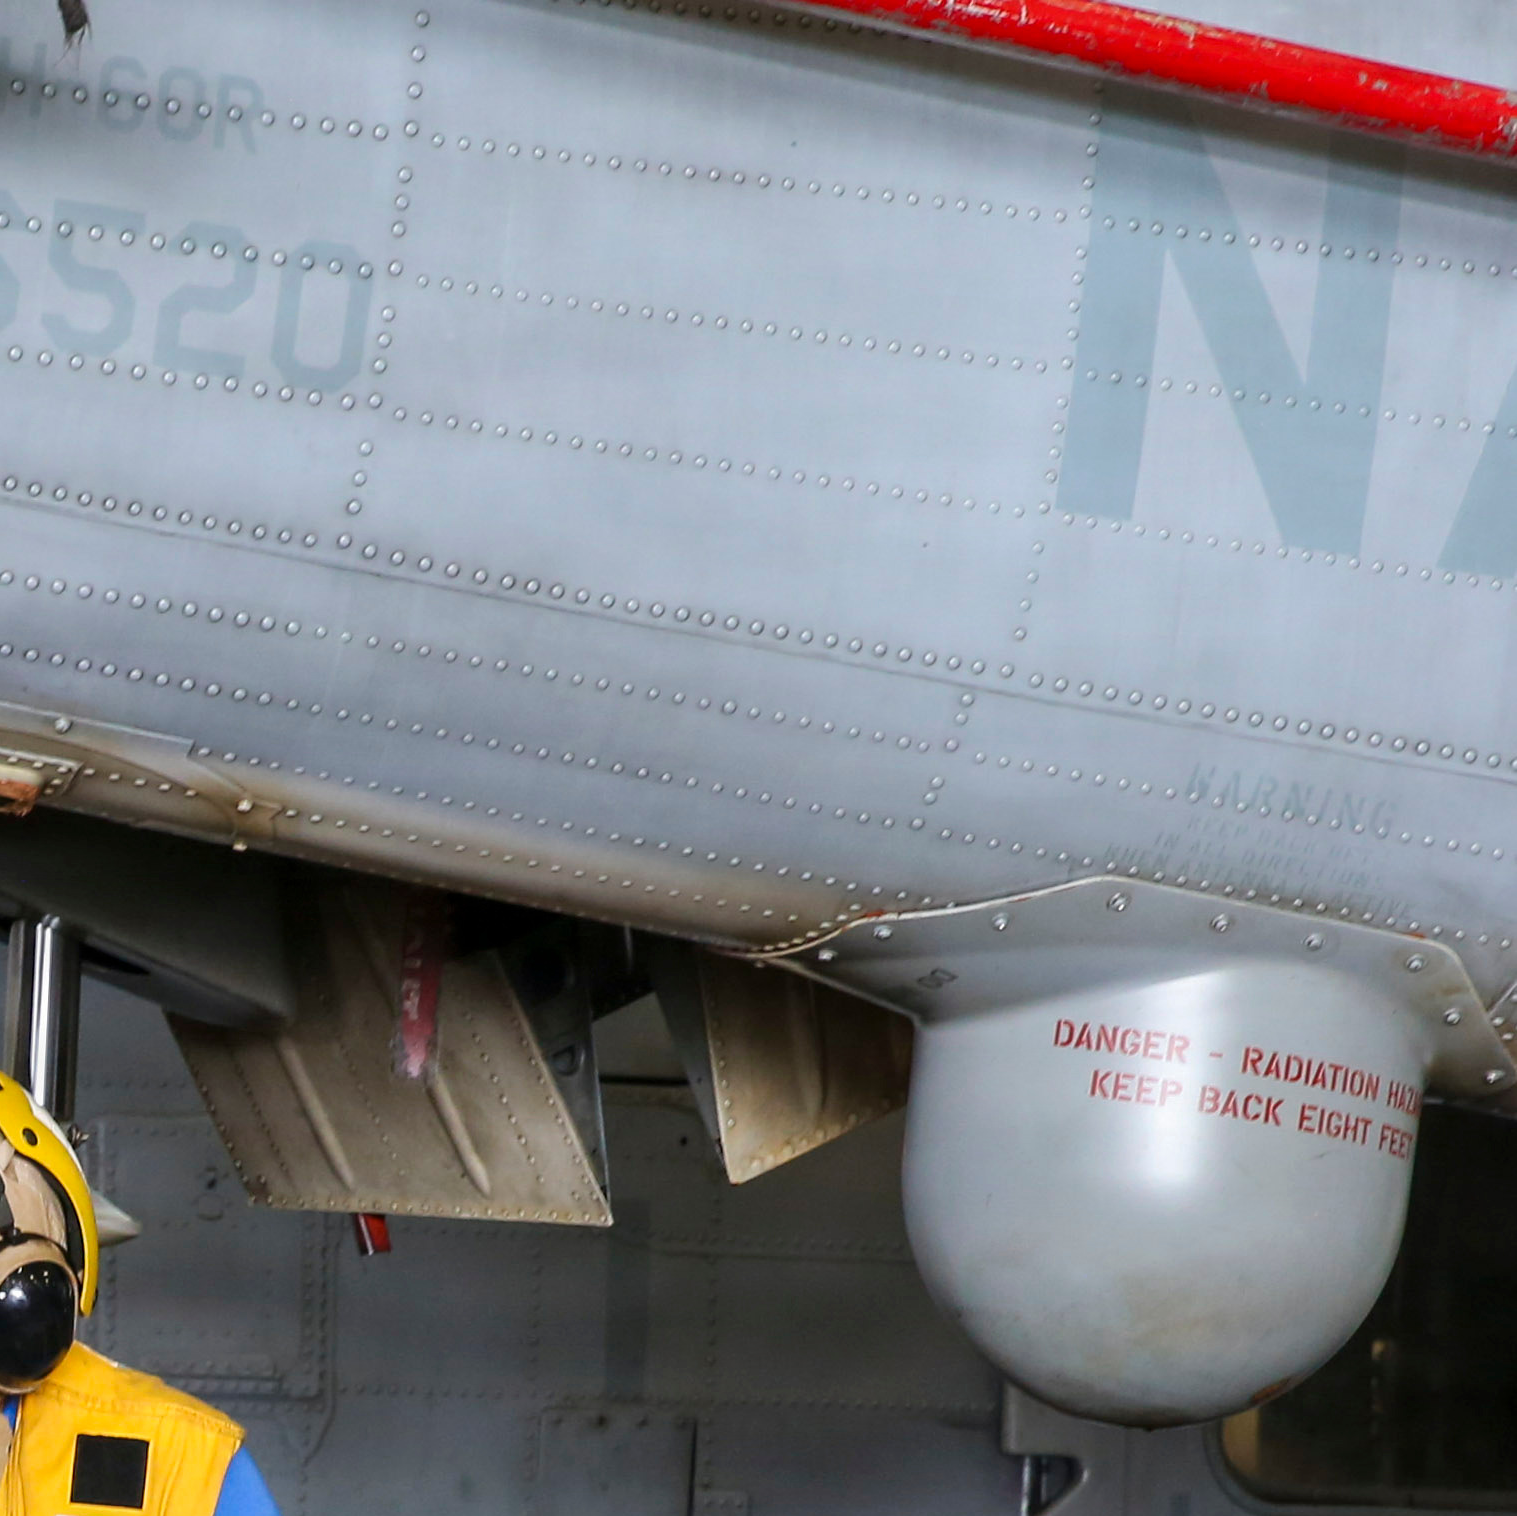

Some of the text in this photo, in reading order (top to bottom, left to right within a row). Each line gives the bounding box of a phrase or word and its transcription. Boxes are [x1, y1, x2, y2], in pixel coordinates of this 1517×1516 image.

[1184, 762, 1399, 838] WARNING
[1053, 1018, 1190, 1063] DANGER
[1240, 1046, 1380, 1102] RADIATION
[1088, 1068, 1414, 1161] KEEP BACK EIGHT FEET
